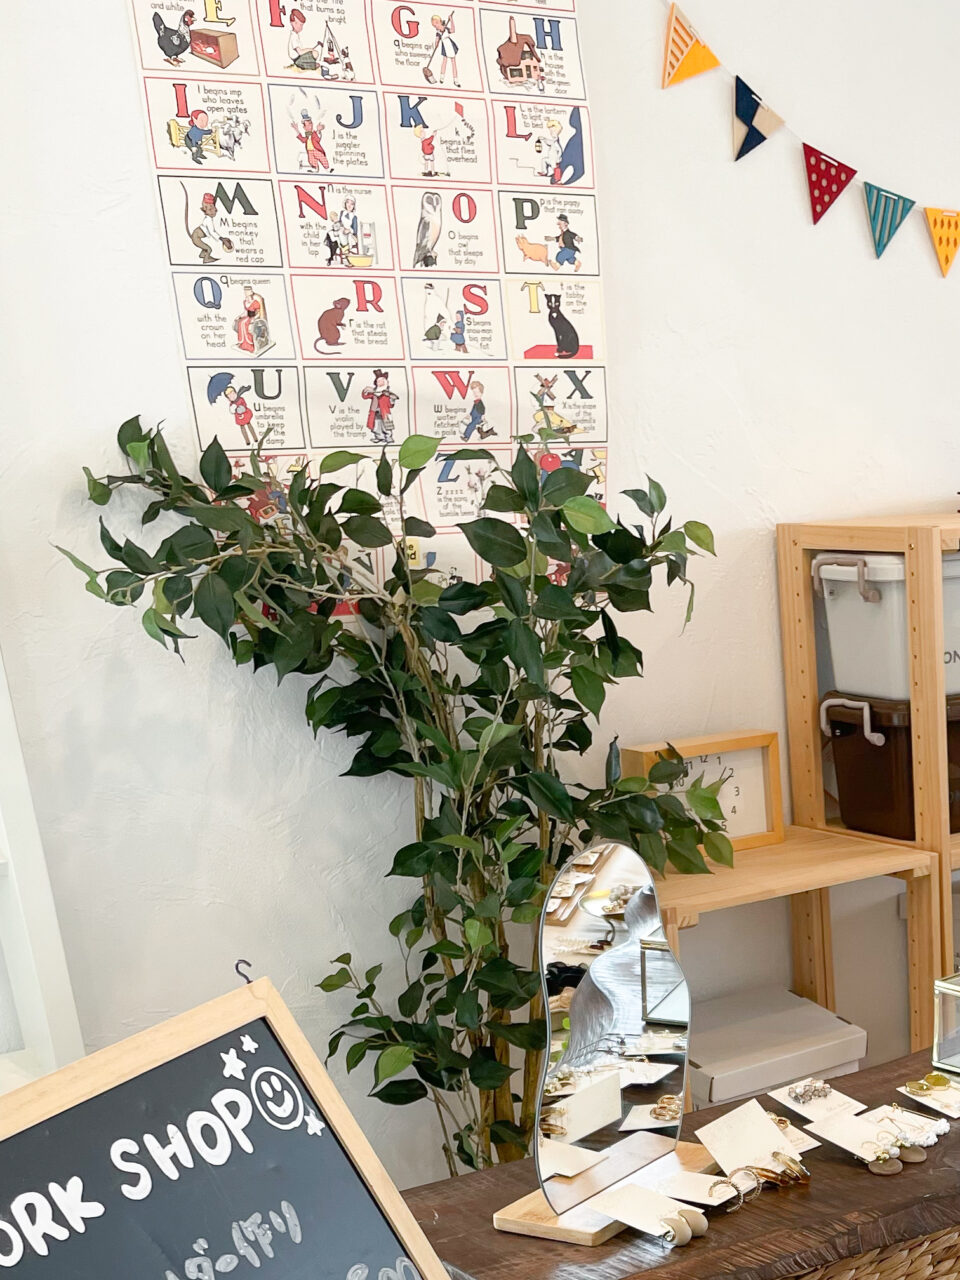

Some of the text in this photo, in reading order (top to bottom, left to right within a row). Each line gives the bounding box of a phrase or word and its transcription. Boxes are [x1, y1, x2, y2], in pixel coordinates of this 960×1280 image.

[391, 5, 420, 39] G
[533, 17, 563, 51] H
[173, 83, 190, 118] I
[203, 86, 242, 97] begins imp
[220, 96, 244, 104] leaves
[207, 106, 248, 114] open gates
[336, 95, 363, 129] J
[398, 95, 429, 129] K
[504, 105, 532, 141] L
[335, 141, 361, 150] juggler
[345, 132, 357, 140] the
[333, 157, 368, 167] the plates
[335, 151, 365, 159] spinning
[214, 182, 259, 215] M
[294, 185, 328, 220] N
[452, 193, 477, 223] O
[512, 197, 540, 230] P
[228, 230, 258, 238] monkey
[232, 219, 257, 228] begins
[193, 276, 222, 309] Q
[352, 280, 384, 313] R
[462, 283, 489, 316] S
[521, 281, 546, 314] T
[197, 314, 227, 322] with the
[206, 340, 226, 348] head
[251, 369, 282, 400] U
[326, 372, 355, 403] V
[431, 371, 475, 400] W
[563, 370, 594, 399] X
[330, 423, 354, 432] played
[733, 786, 741, 797] 3
[730, 806, 737, 815] 4
[0, 1088, 255, 1268] ORK SHOP
